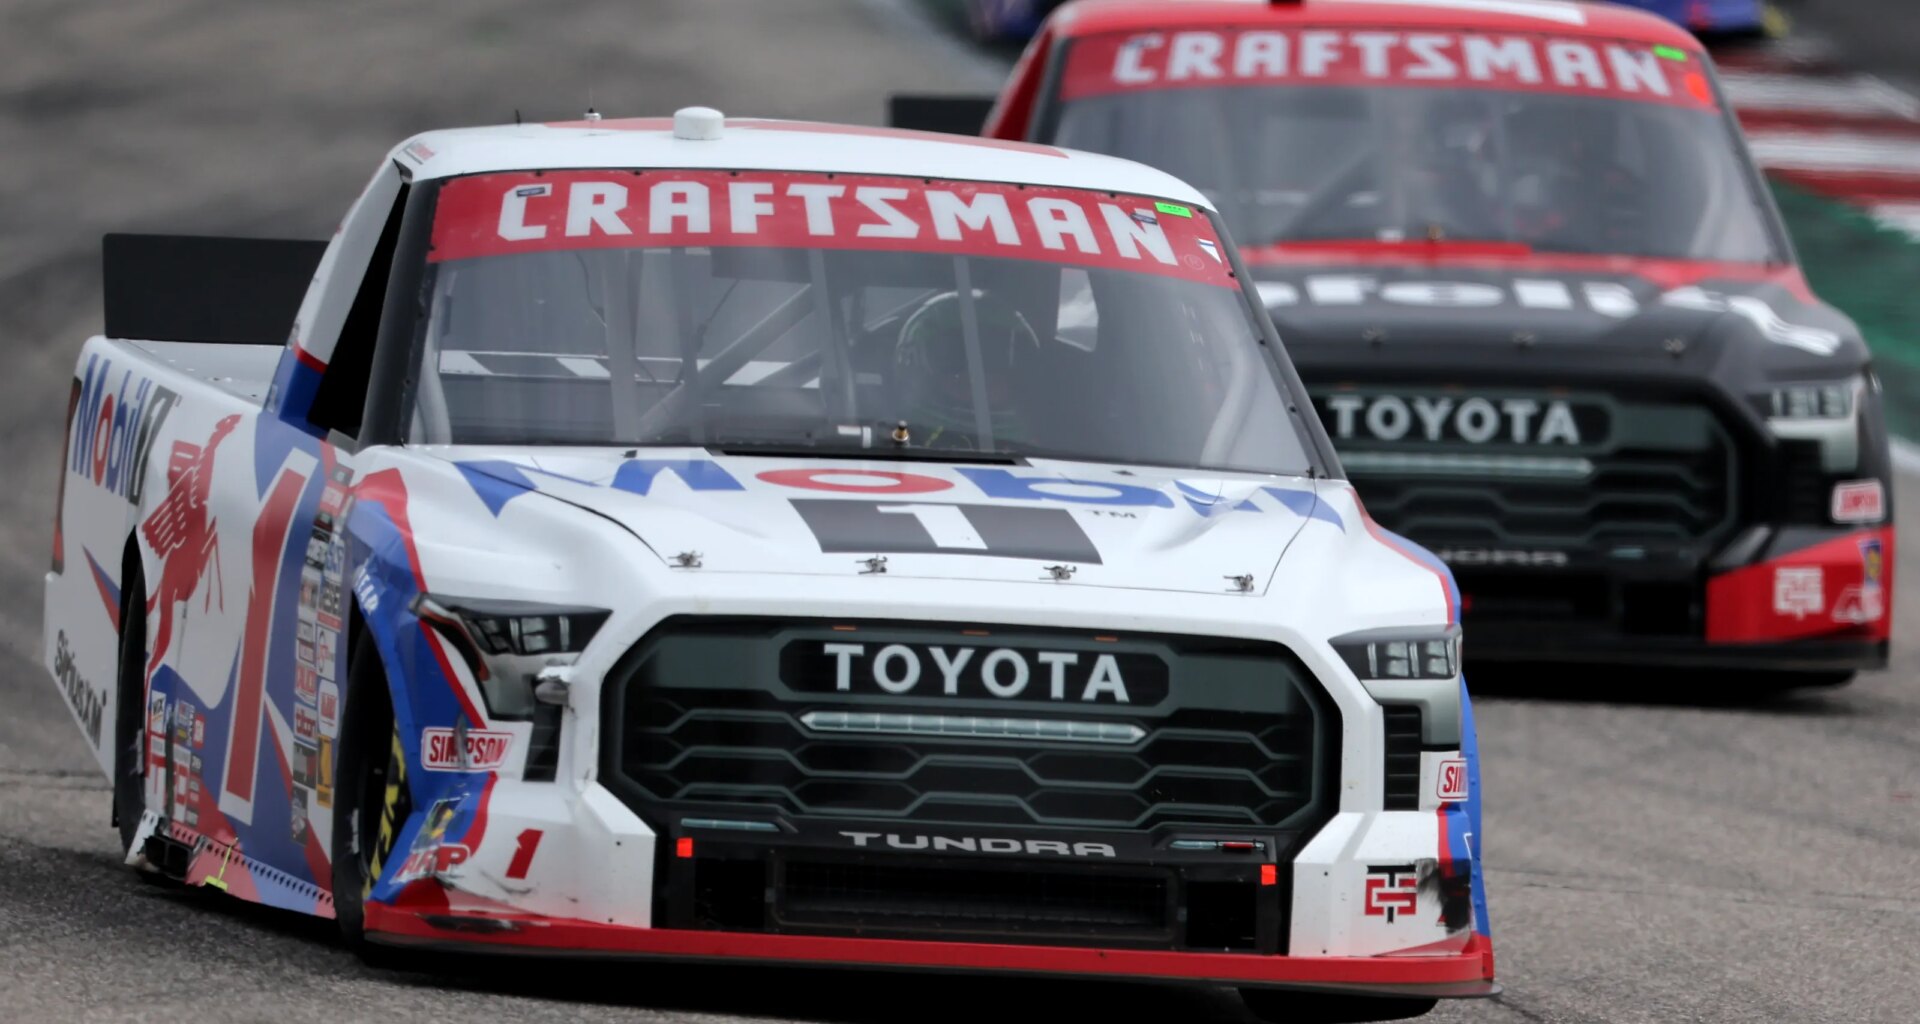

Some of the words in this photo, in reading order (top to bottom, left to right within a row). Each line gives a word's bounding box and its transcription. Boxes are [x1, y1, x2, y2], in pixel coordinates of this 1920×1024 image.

[1112, 32, 1671, 97] CRAFTSMAN
[497, 179, 1178, 266] CRAFTSMAN
[72, 352, 152, 497] Mobil
[1326, 393, 1581, 446] TOYOTA
[877, 503, 988, 550] 1
[218, 446, 319, 827] 1
[54, 628, 103, 751] SiriusXM
[823, 642, 1131, 704] TOYOTA
[505, 828, 544, 880] 1
[838, 830, 1116, 859] TUNDRA
